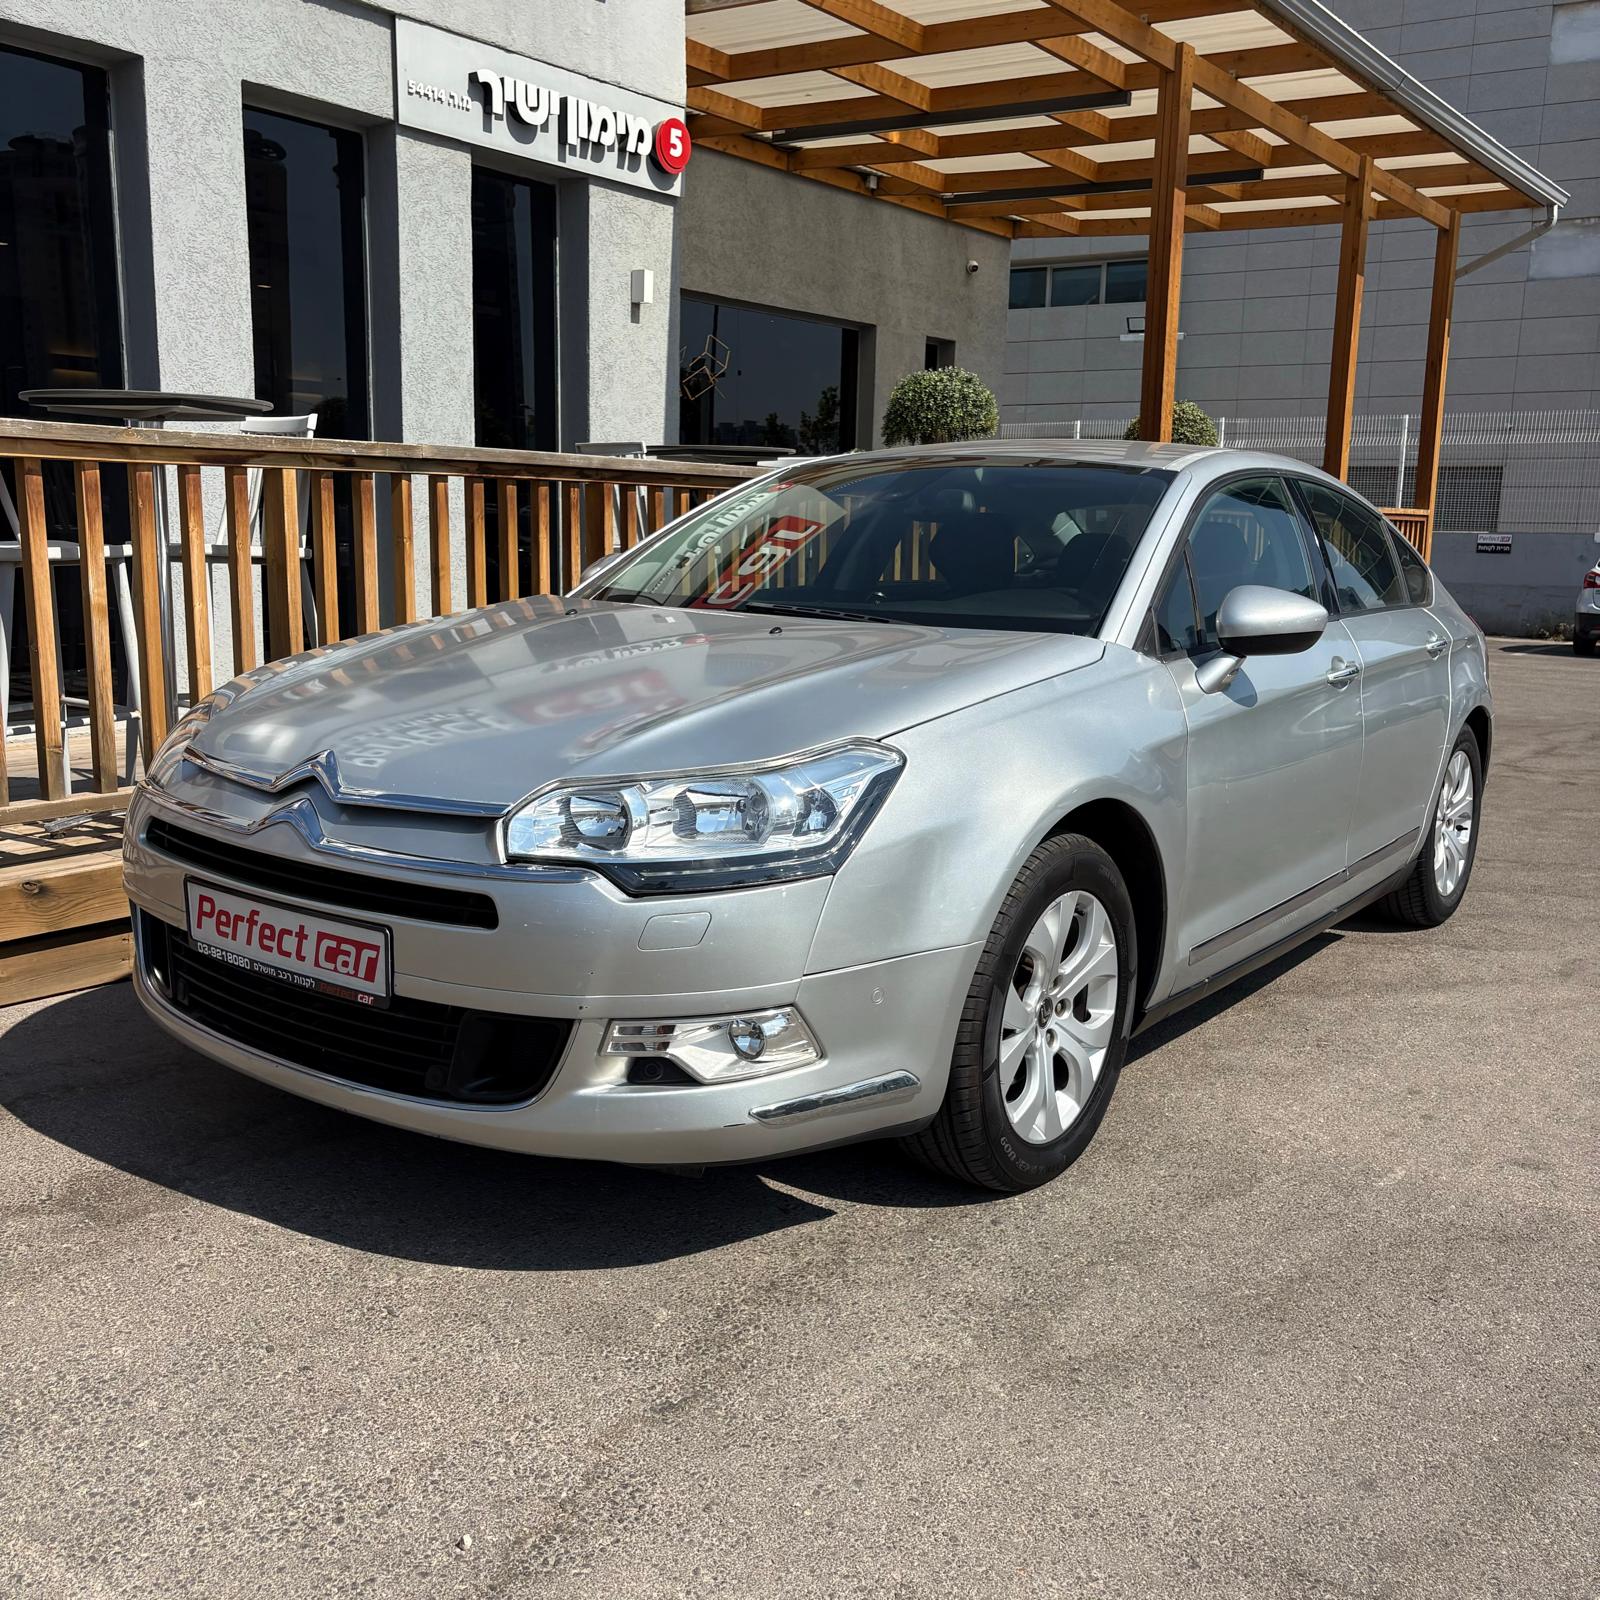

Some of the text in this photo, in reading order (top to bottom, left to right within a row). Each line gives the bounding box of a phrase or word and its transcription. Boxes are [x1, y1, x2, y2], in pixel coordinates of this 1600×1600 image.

[407, 79, 447, 102] 54414
[476, 68, 683, 158] 5 מימון ישיר
[196, 894, 378, 979] Perfect car
[197, 942, 251, 970] 03-9218080
[253, 962, 316, 989] לקנות רכב מושלם
[357, 993, 374, 1005] car
